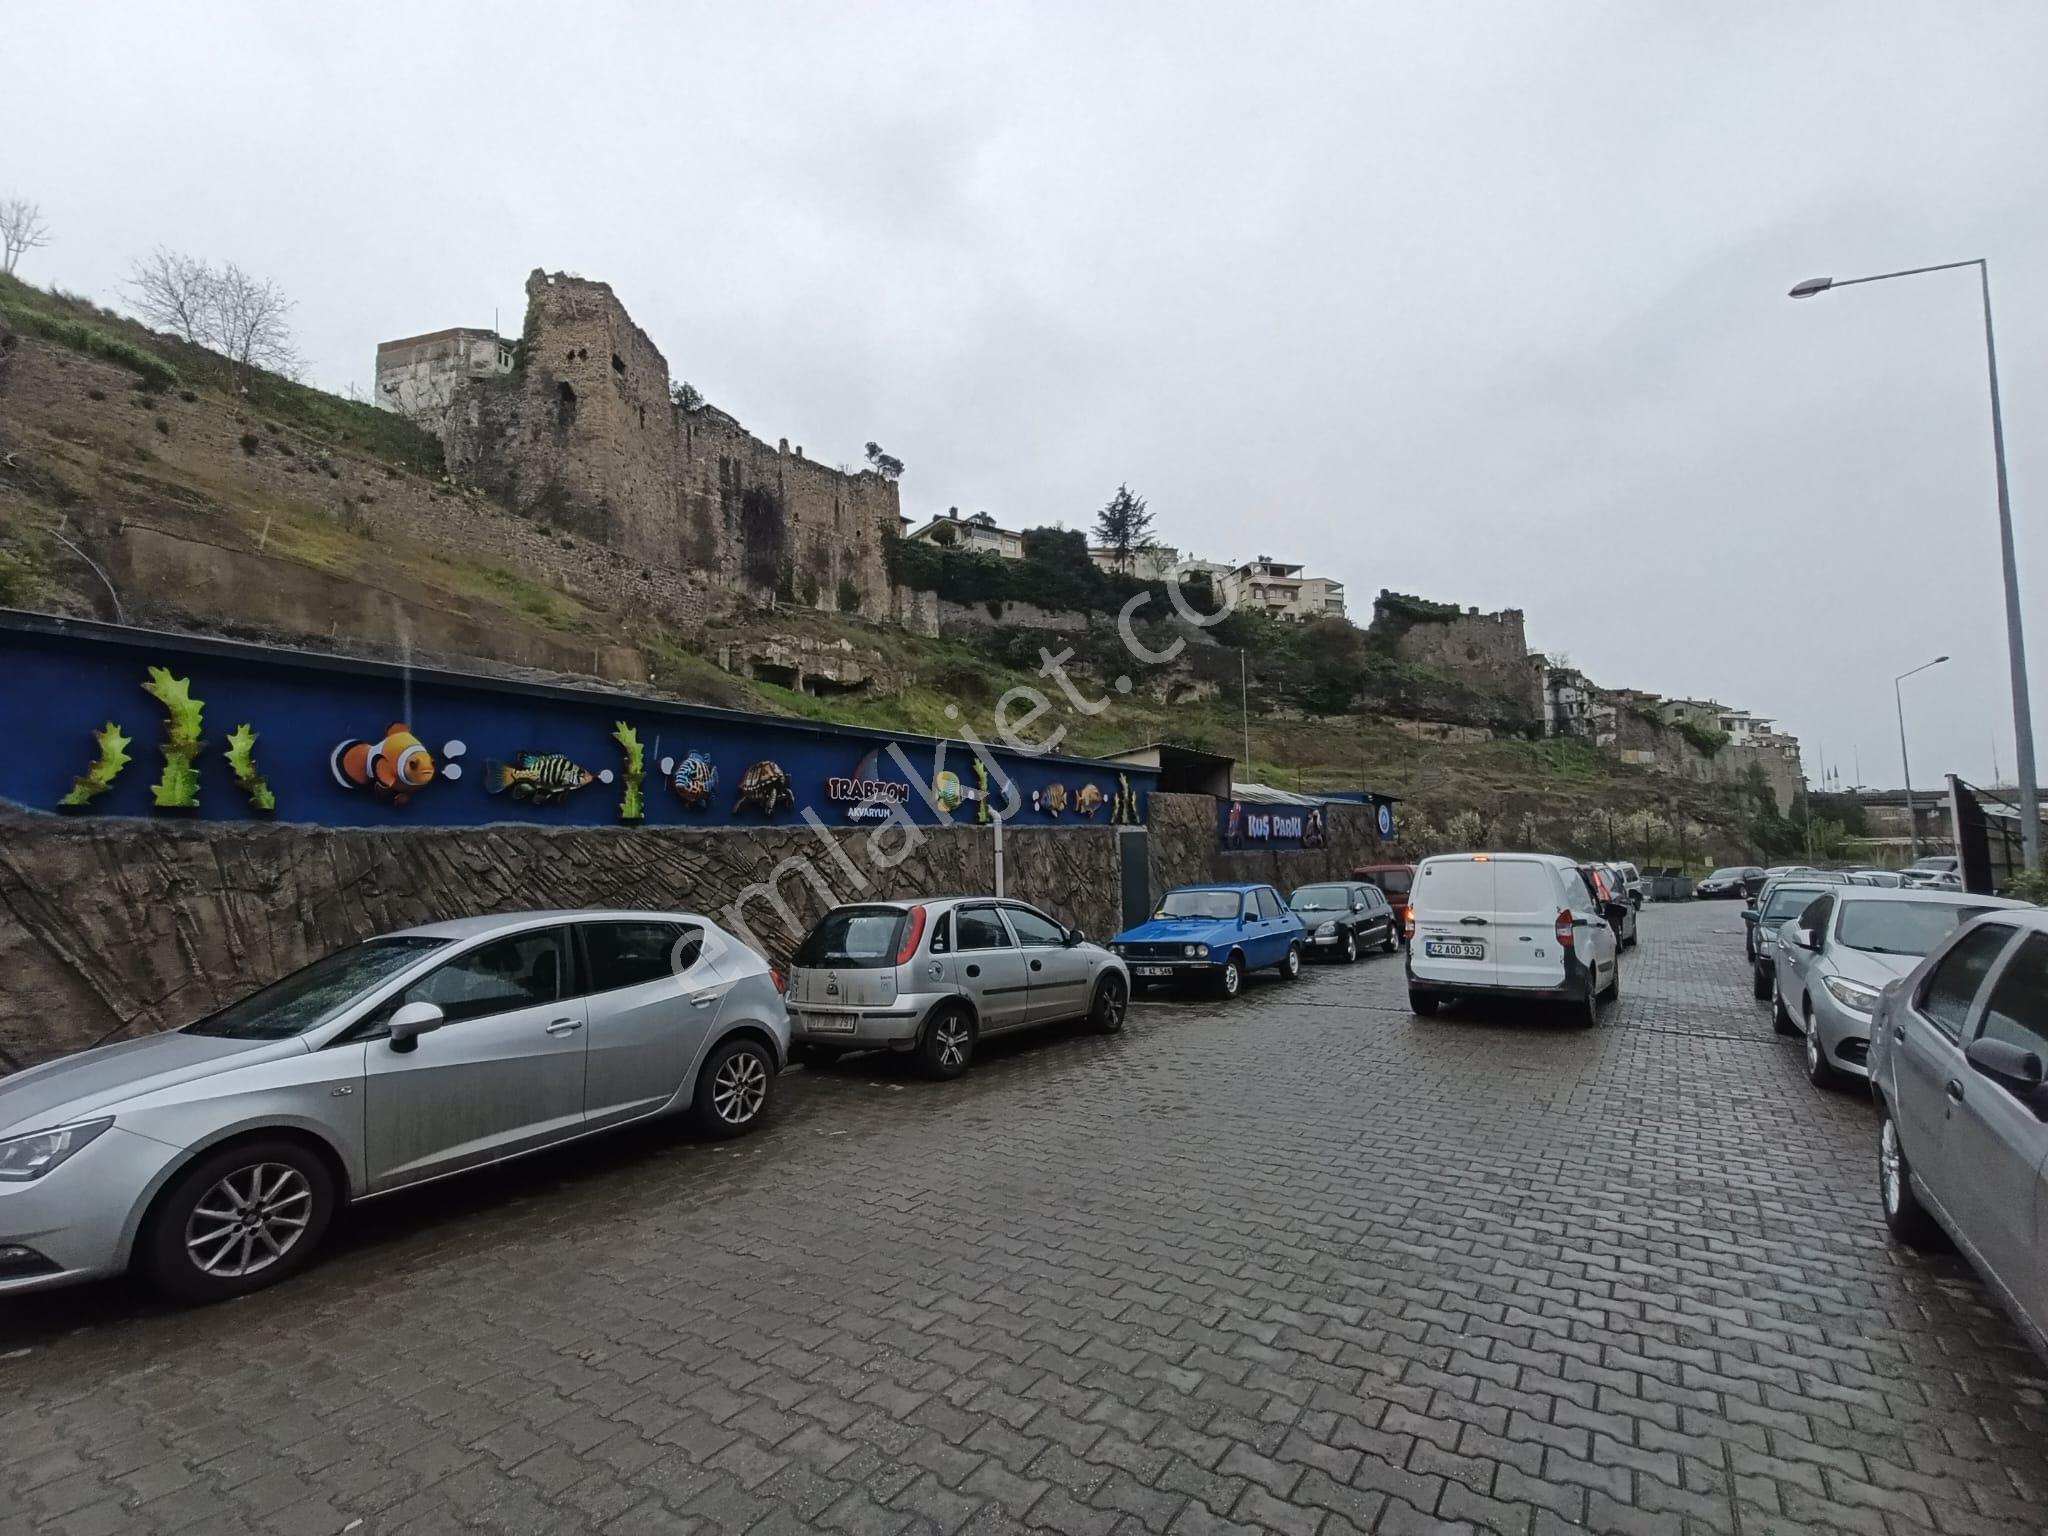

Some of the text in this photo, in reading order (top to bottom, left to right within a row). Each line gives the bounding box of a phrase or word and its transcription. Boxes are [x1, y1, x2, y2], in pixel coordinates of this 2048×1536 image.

[829, 778, 909, 803] TRABZON
[848, 807, 890, 818] AKVARYUM
[1431, 944, 1443, 954] 42
[1463, 946, 1481, 956] 932
